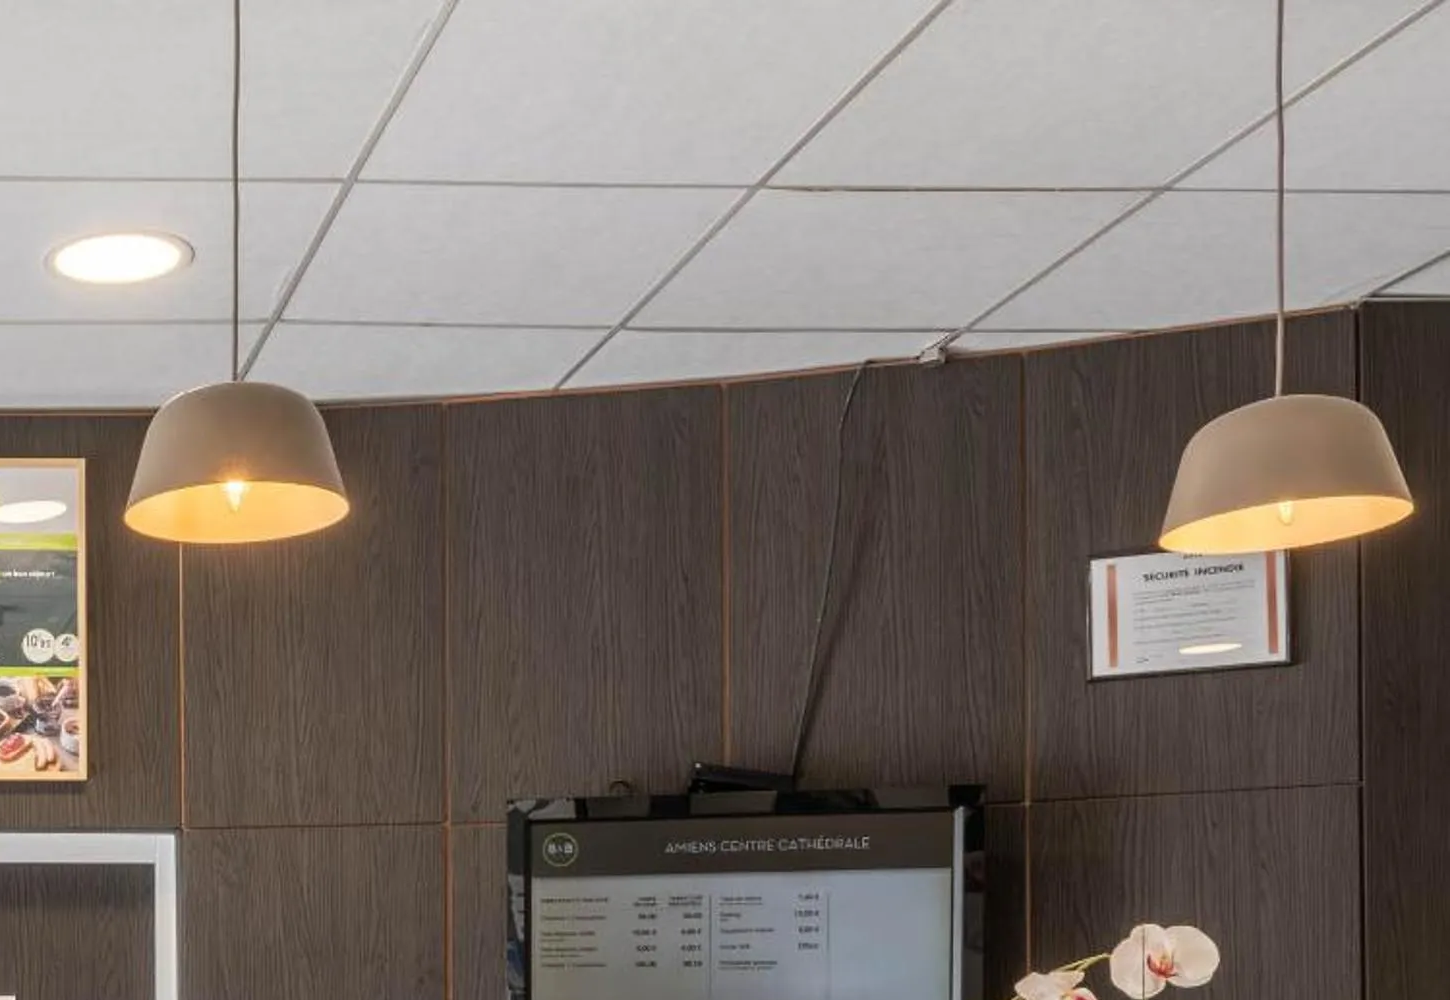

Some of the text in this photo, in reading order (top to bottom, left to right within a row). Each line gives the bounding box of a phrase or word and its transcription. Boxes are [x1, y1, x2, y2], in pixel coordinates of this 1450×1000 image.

[664, 834, 871, 855] AMIENS CENTRE CATHÉDRALE
